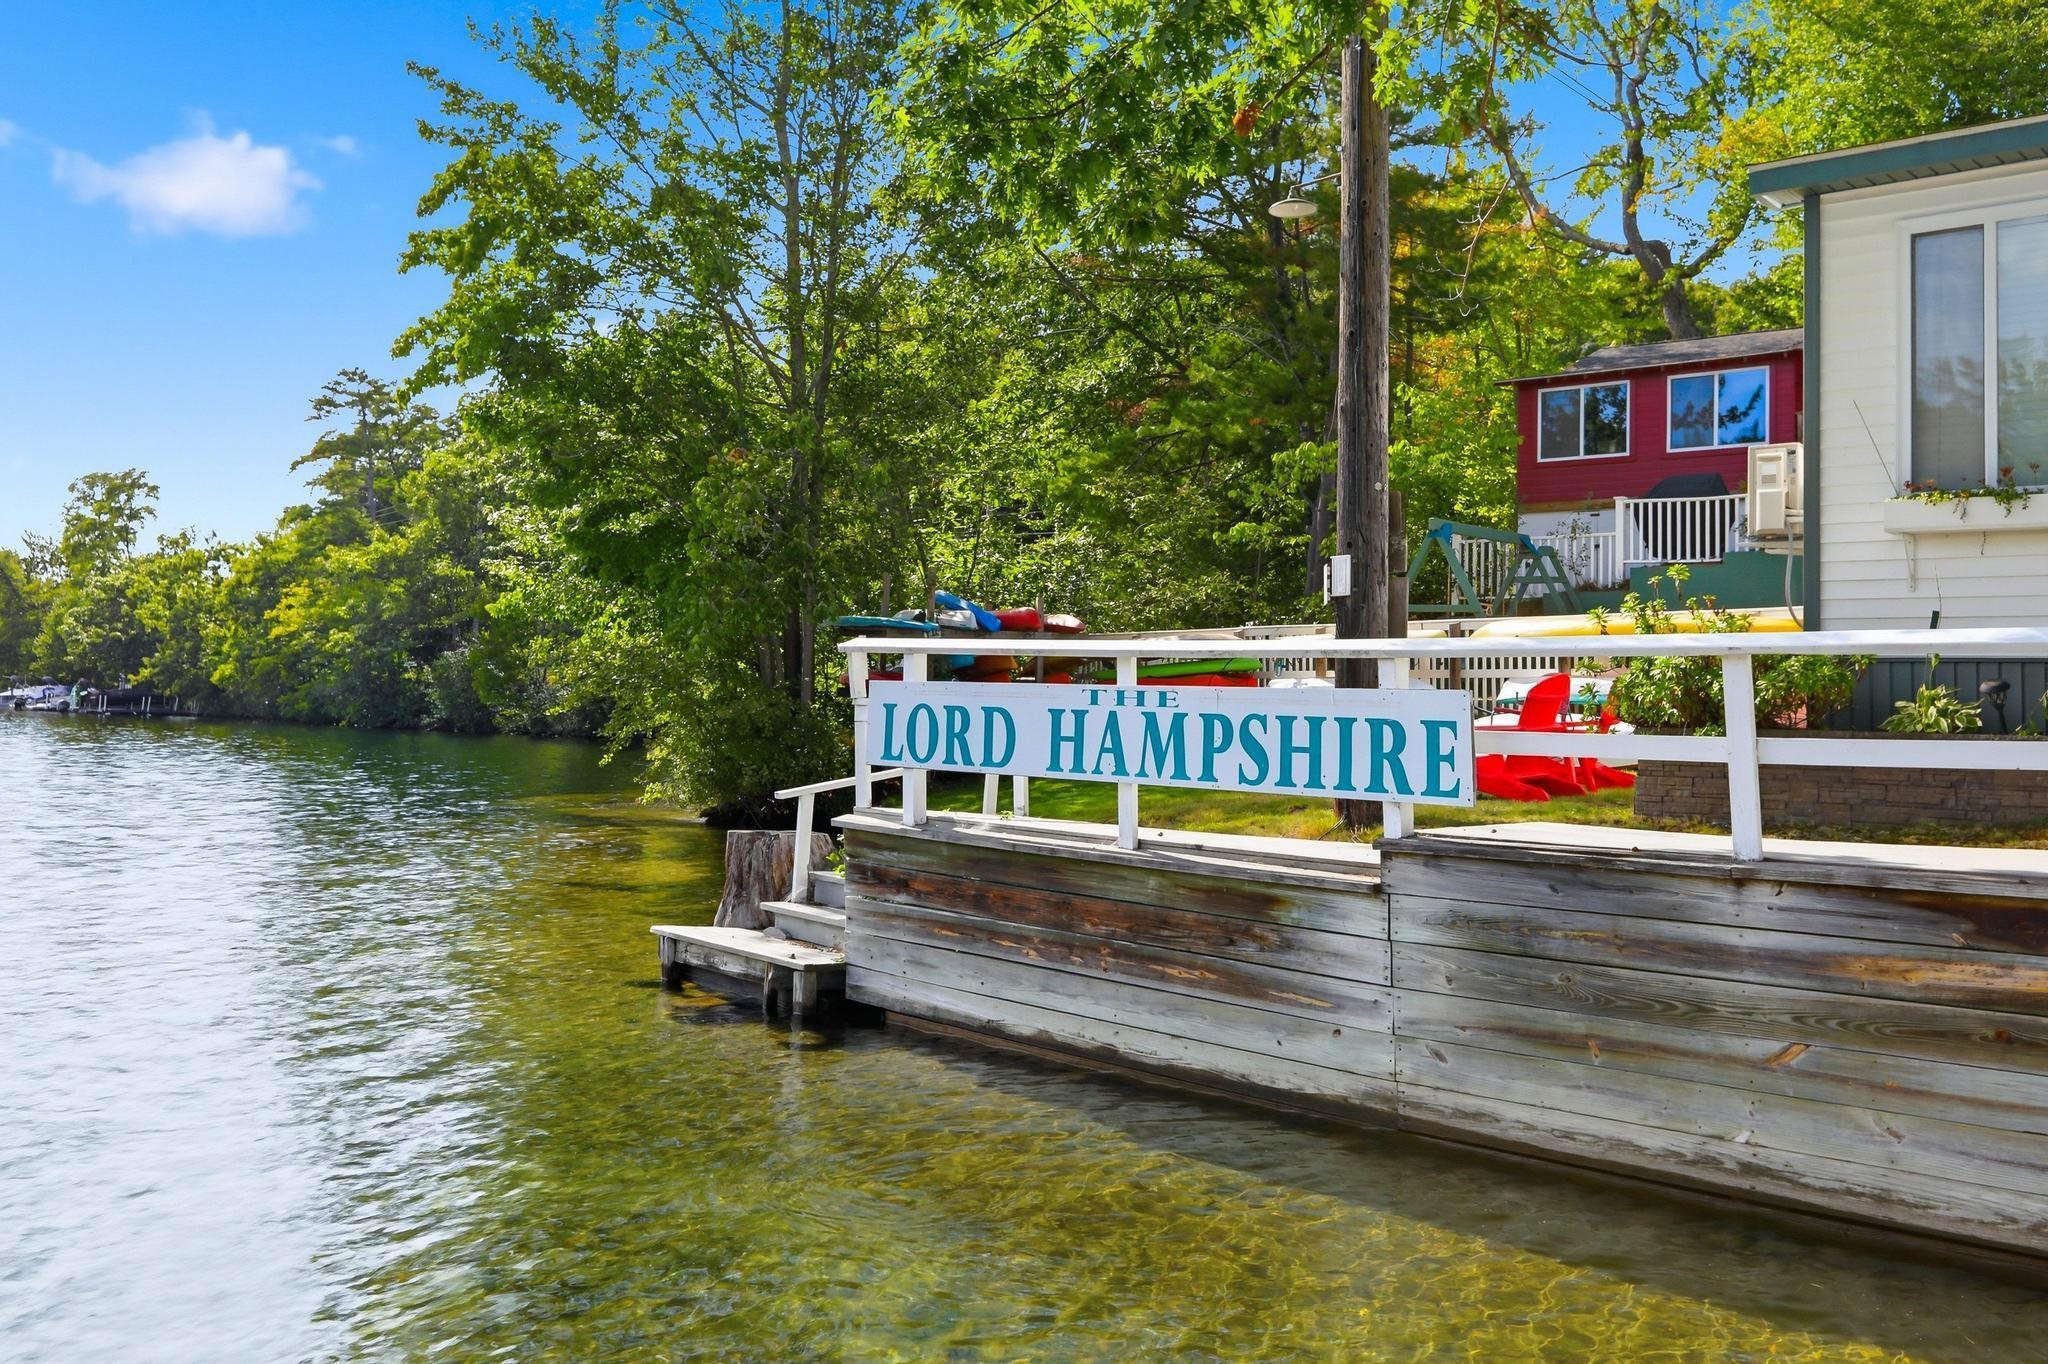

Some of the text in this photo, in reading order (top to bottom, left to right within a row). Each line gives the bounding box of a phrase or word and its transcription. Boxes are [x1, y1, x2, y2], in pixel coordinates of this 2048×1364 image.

[1081, 688, 1180, 708] THE
[880, 702, 1460, 798] LORD HAMPSHIRE
